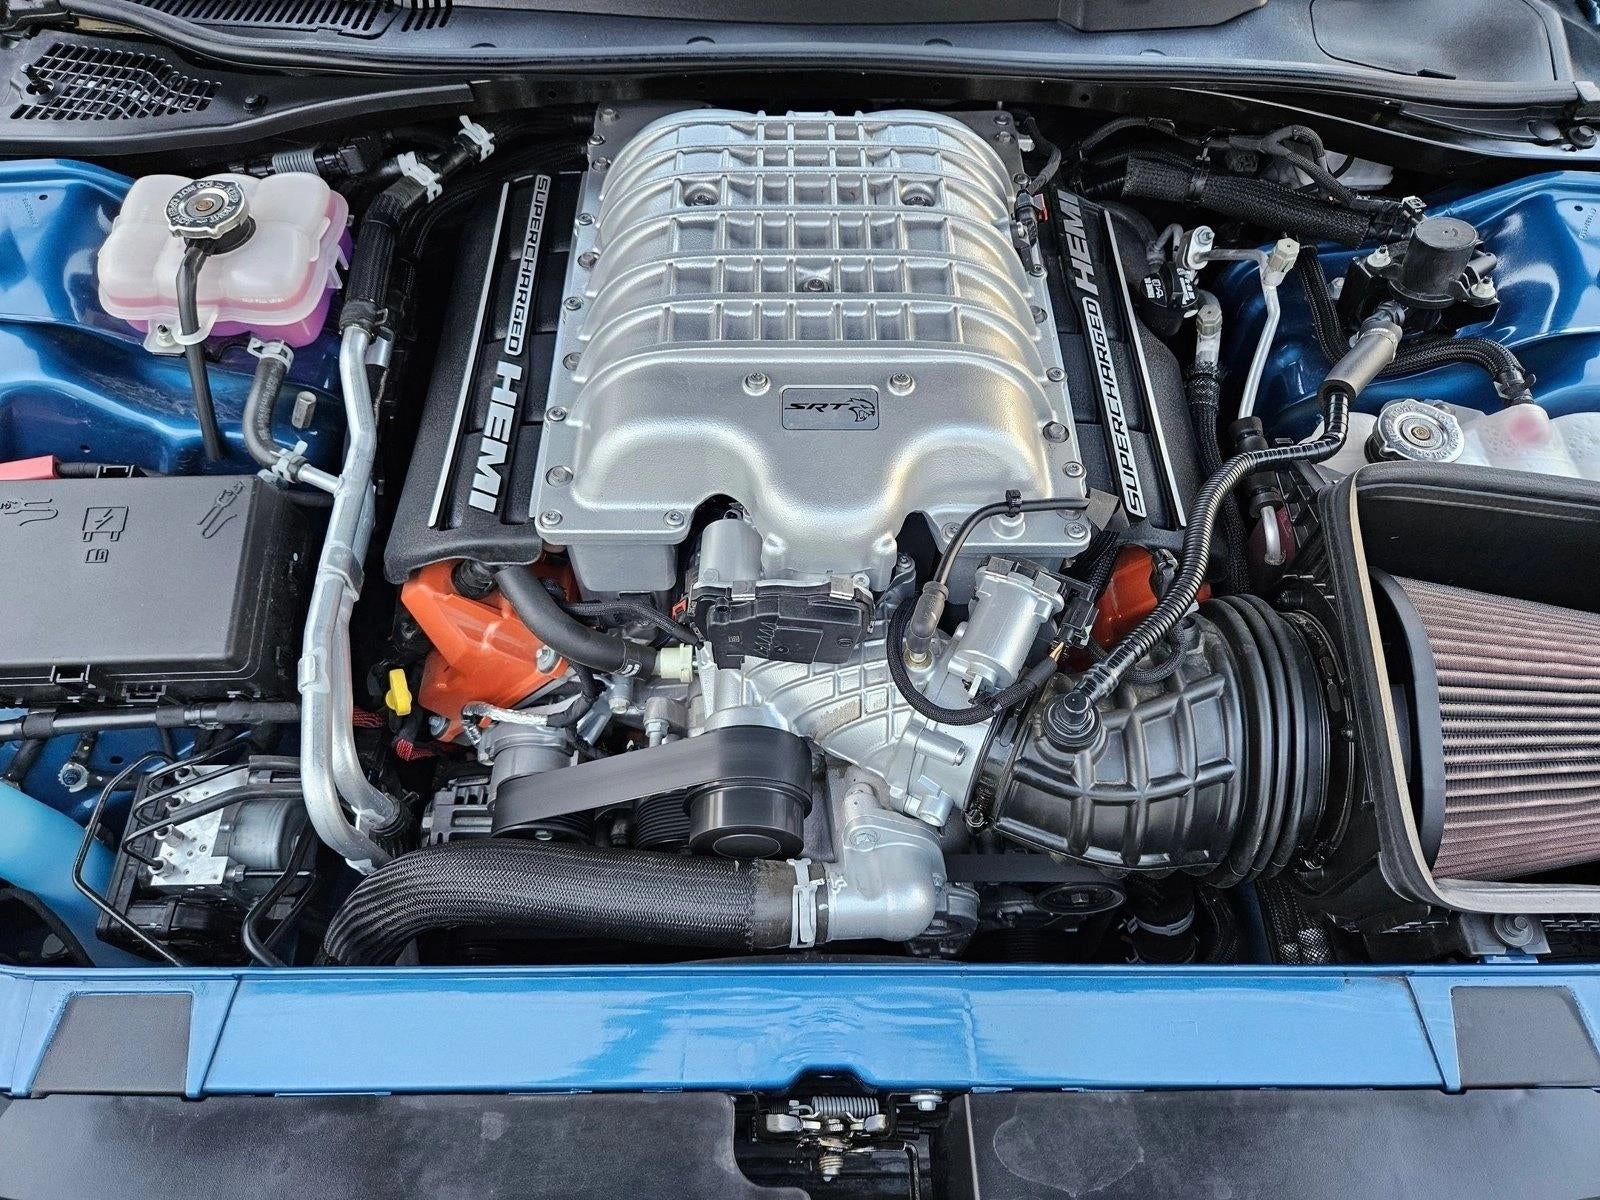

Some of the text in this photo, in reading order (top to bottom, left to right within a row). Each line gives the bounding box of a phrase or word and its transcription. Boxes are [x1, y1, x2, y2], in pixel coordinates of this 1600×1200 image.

[177, 184, 197, 200] NOT
[196, 181, 213, 189] DO
[469, 177, 549, 512] SUPERCHARGED HEMI
[1057, 189, 1143, 516] SUPERCHARGED HEMI
[785, 403, 850, 412] SRT
